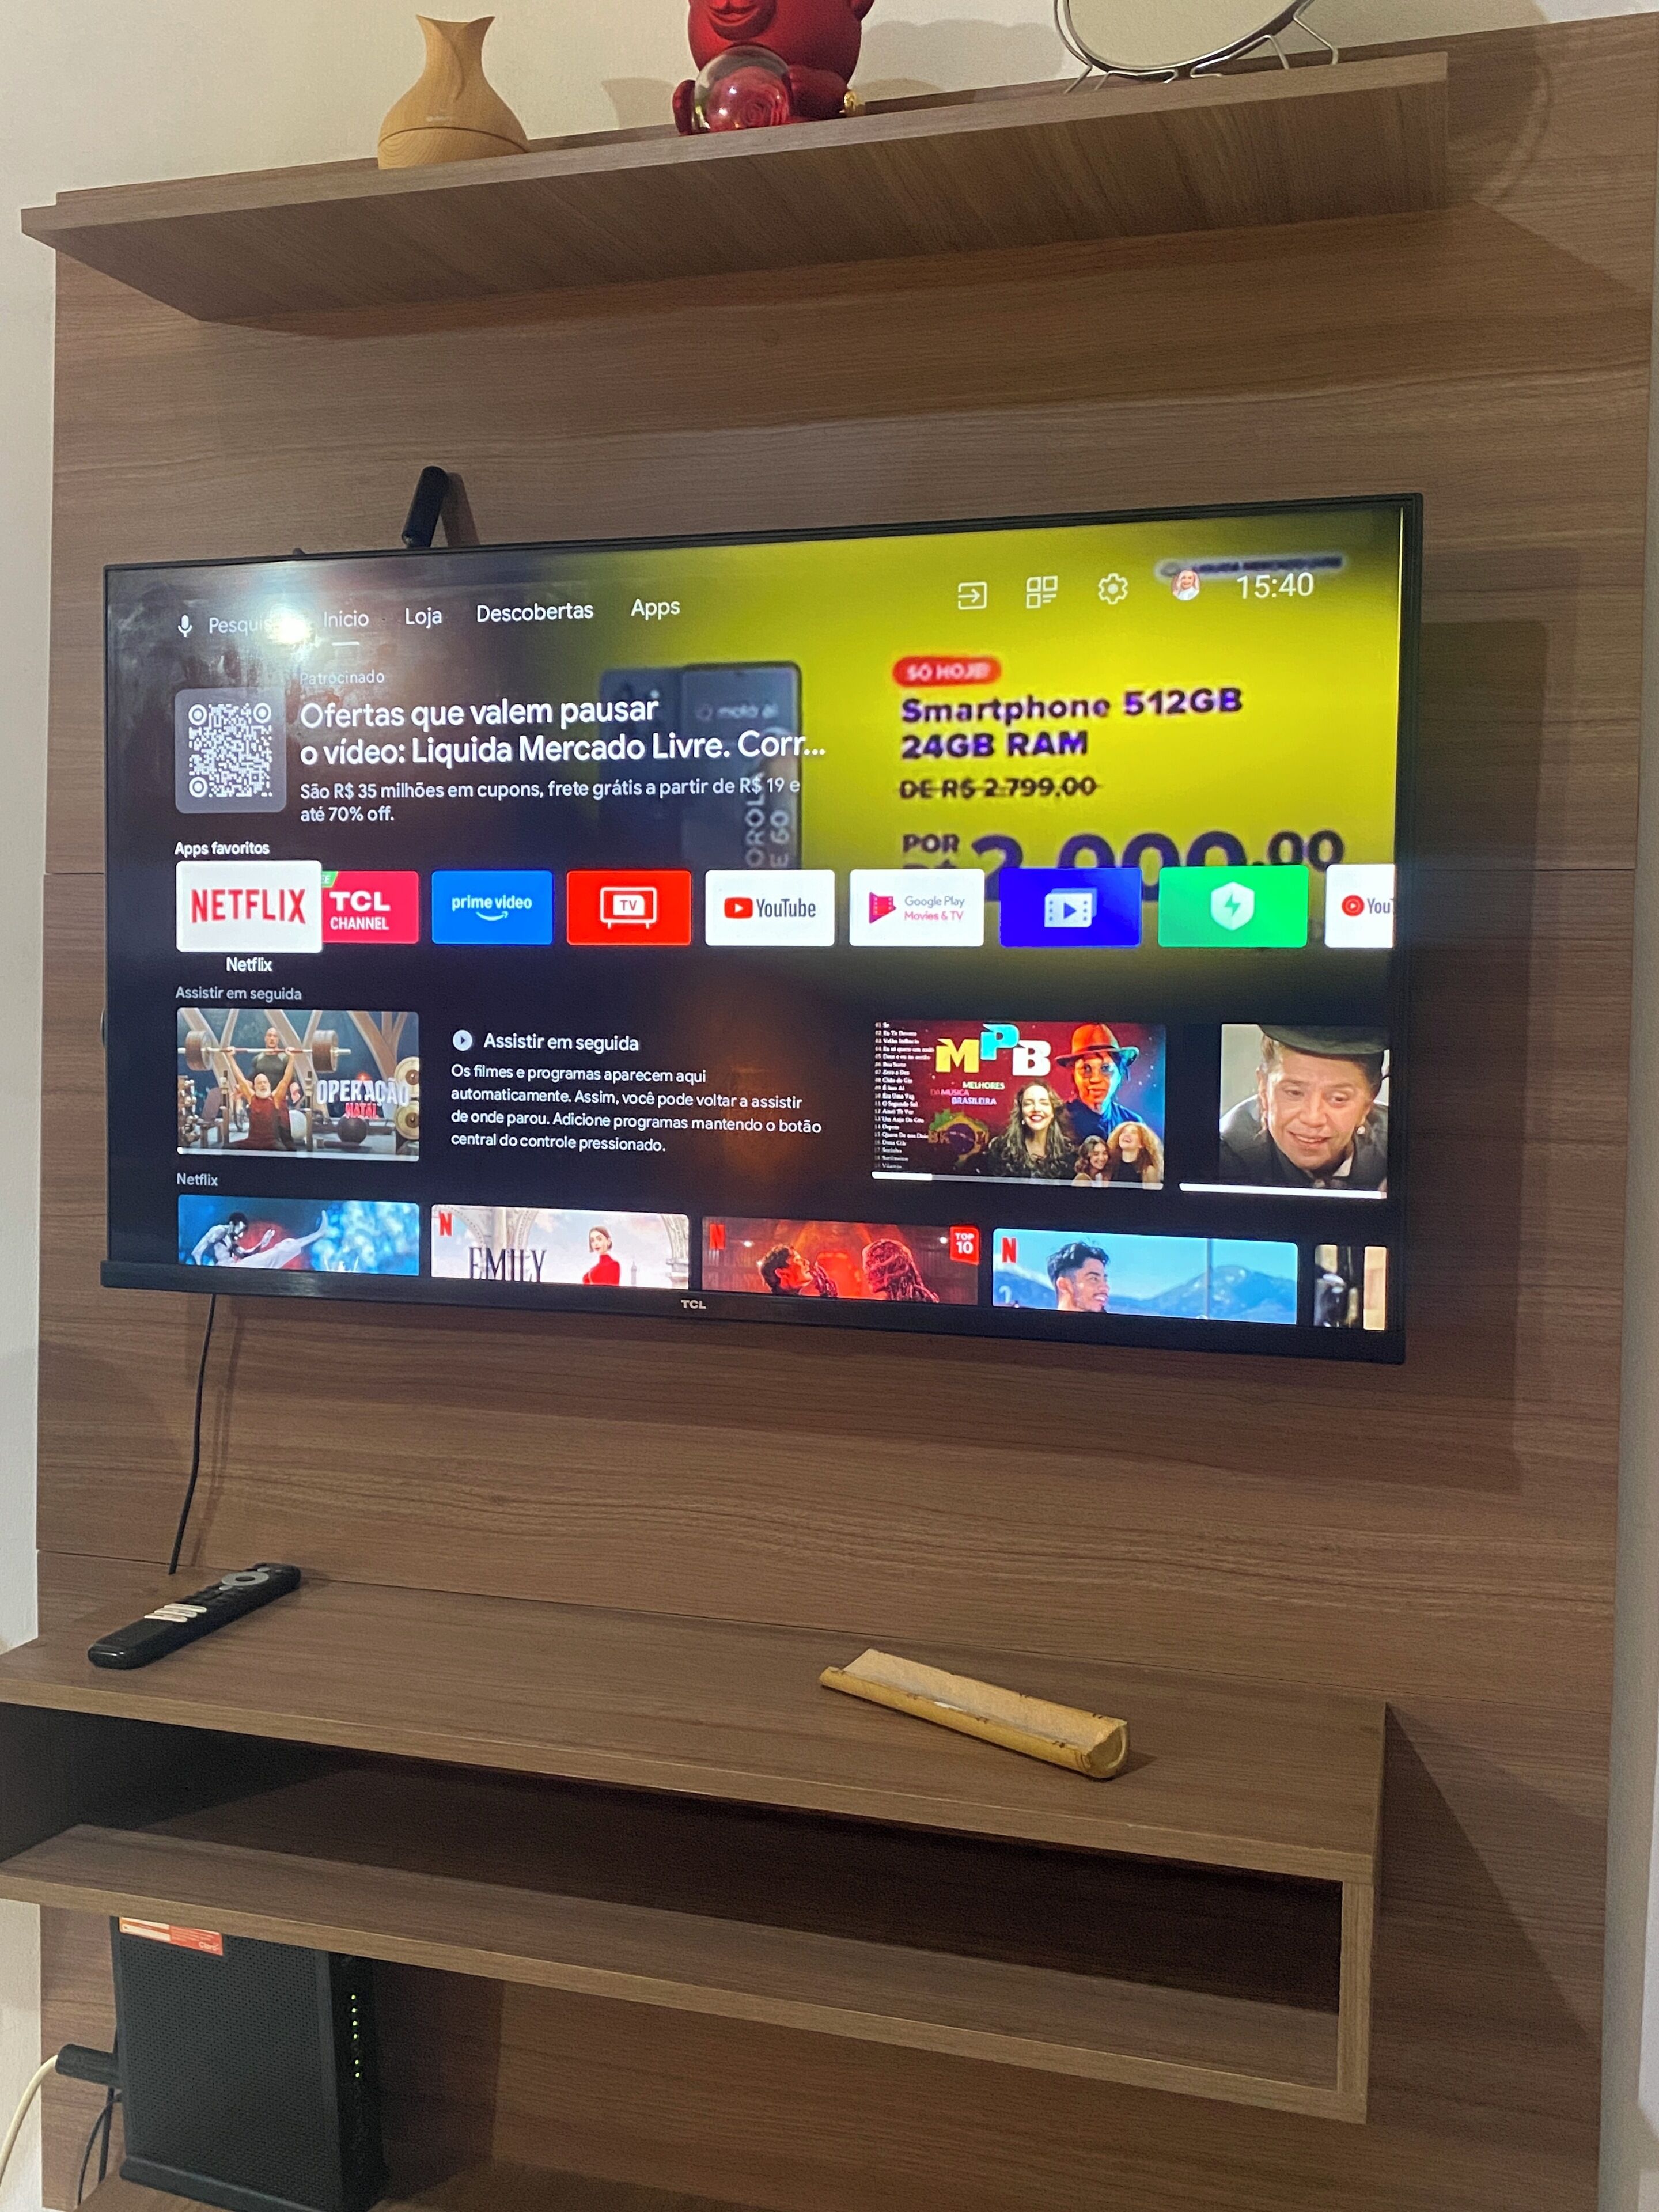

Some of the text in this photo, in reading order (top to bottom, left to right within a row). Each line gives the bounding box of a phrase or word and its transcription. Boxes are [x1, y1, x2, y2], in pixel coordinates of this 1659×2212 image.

[1237, 572, 1314, 599] 15:40
[406, 607, 443, 628] Loja
[477, 602, 594, 622] Descobertas
[631, 599, 680, 620] Apps
[209, 616, 282, 636] Pesquis
[300, 669, 385, 685] Patrocinado
[300, 698, 659, 732] Ofertas que valem pausar
[902, 687, 1243, 726] Smartphone 512GB
[300, 745, 318, 766] o
[323, 738, 405, 765] vídeo:
[412, 735, 513, 770] Liquida
[519, 733, 646, 762] Mercado
[652, 732, 730, 760] Livre.
[902, 730, 1088, 760] 24GB RAM
[301, 777, 800, 801] São R$ 35 milhões em cupons, frete grátis a partir de R$ 19 e
[899, 779, 934, 800] DE
[942, 777, 976, 800] R$
[301, 805, 395, 823] até 70% off.
[174, 840, 271, 858] Apps favoritos
[902, 834, 960, 854] POR
[191, 888, 306, 925] NETFLIX
[329, 890, 391, 912] TCL
[452, 894, 533, 912] prime video
[619, 899, 637, 911] TV
[756, 897, 817, 918] YouTube
[904, 895, 966, 909] Google Play
[329, 915, 390, 931] CHANNEL
[904, 910, 964, 921] Movies & TV
[225, 956, 273, 972] Netflix
[175, 986, 303, 1003] Assistir em seguida
[483, 1032, 640, 1055] Assistir em seguida
[935, 1023, 1052, 1077] MPB
[450, 1063, 707, 1086] Os filmes e programas aparecem aqui
[316, 1077, 410, 1107] OPERAÇÃO
[962, 1081, 1006, 1090] MELHORES
[450, 1087, 803, 1109] automaticamente. Assim, você pode voltar a assistir
[951, 1096, 998, 1105] BRASILEIRA
[450, 1109, 823, 1134] de onde parou. Adicione programas mantendo o botão
[450, 1132, 666, 1153] central do controle pressionado.
[176, 1172, 218, 1187] Netflix
[438, 1211, 453, 1236] N
[954, 1232, 975, 1241] TOP
[956, 1241, 974, 1255] 10
[1002, 1237, 1017, 1263] N
[468, 1247, 547, 1282] EMILY
[680, 1299, 707, 1309] TCL
